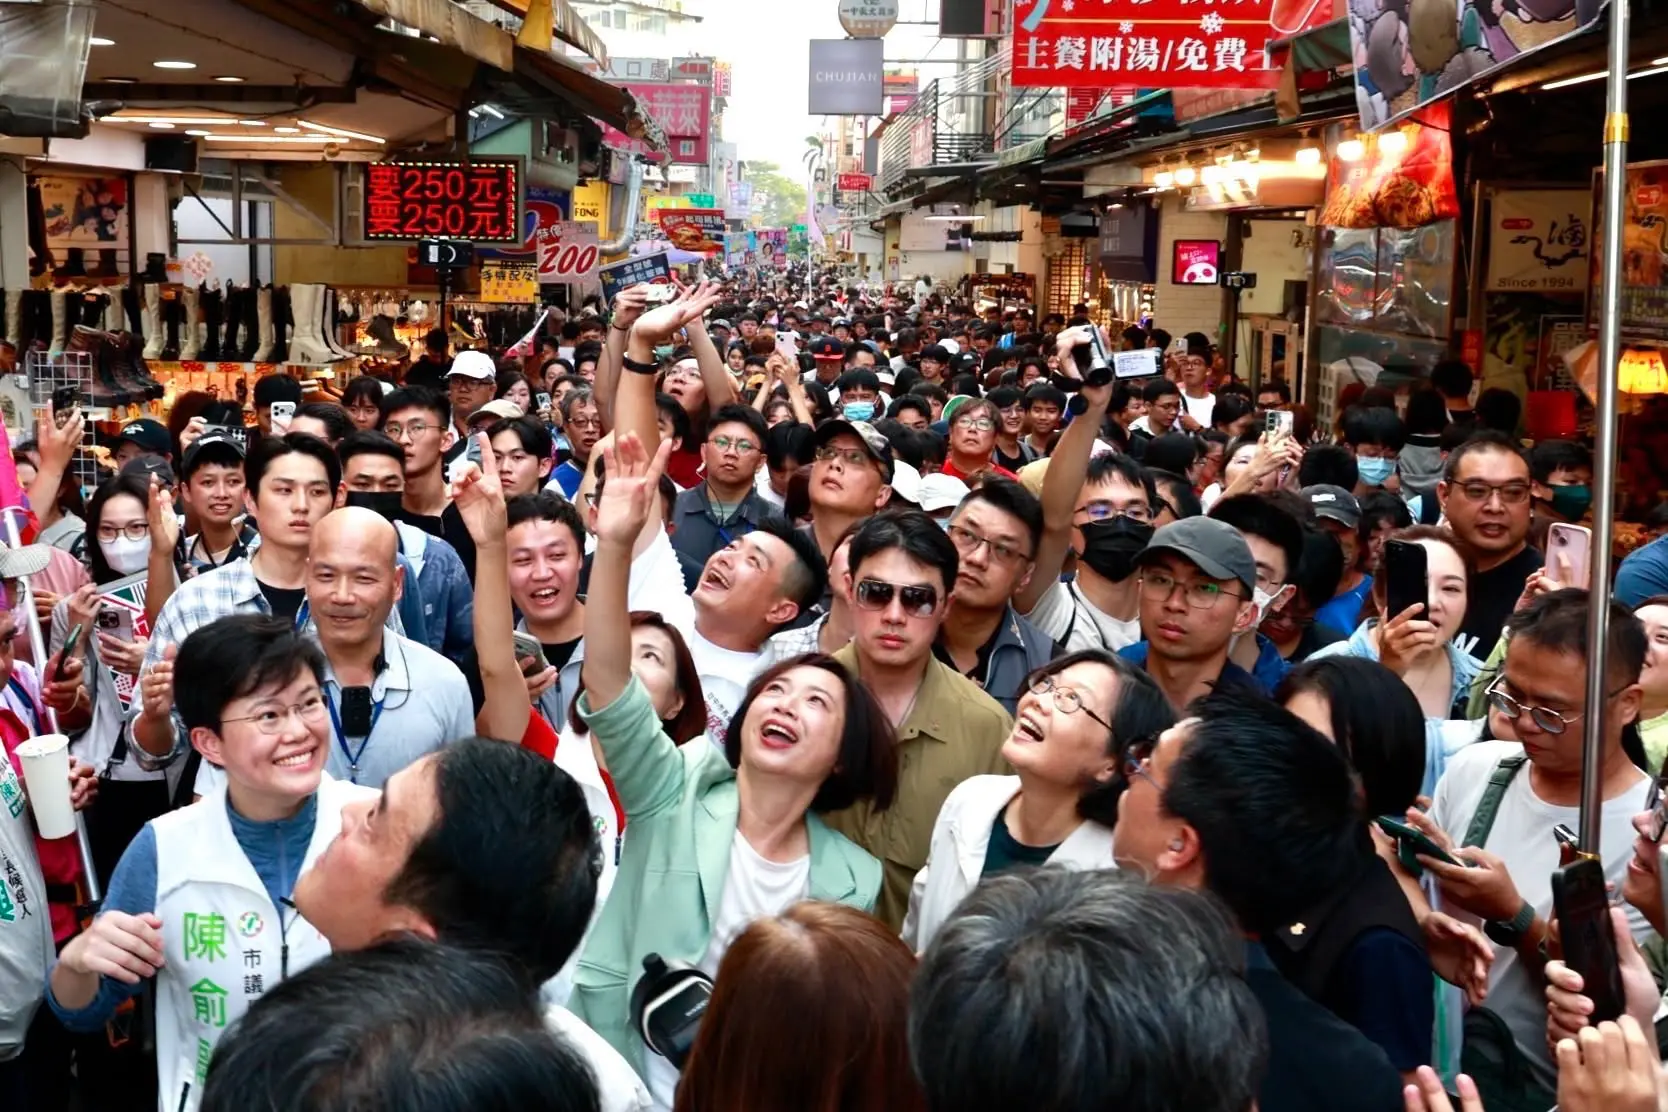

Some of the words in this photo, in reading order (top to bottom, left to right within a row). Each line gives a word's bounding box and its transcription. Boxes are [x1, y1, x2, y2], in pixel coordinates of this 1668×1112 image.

[816, 71, 877, 83] CHUJIAN
[574, 207, 599, 217] FONG
[538, 245, 598, 275] 200
[1498, 277, 1537, 288] Since
[1542, 277, 1574, 288] 1994
[2, 848, 32, 920] 長候選人
[243, 948, 264, 1011] 市議
